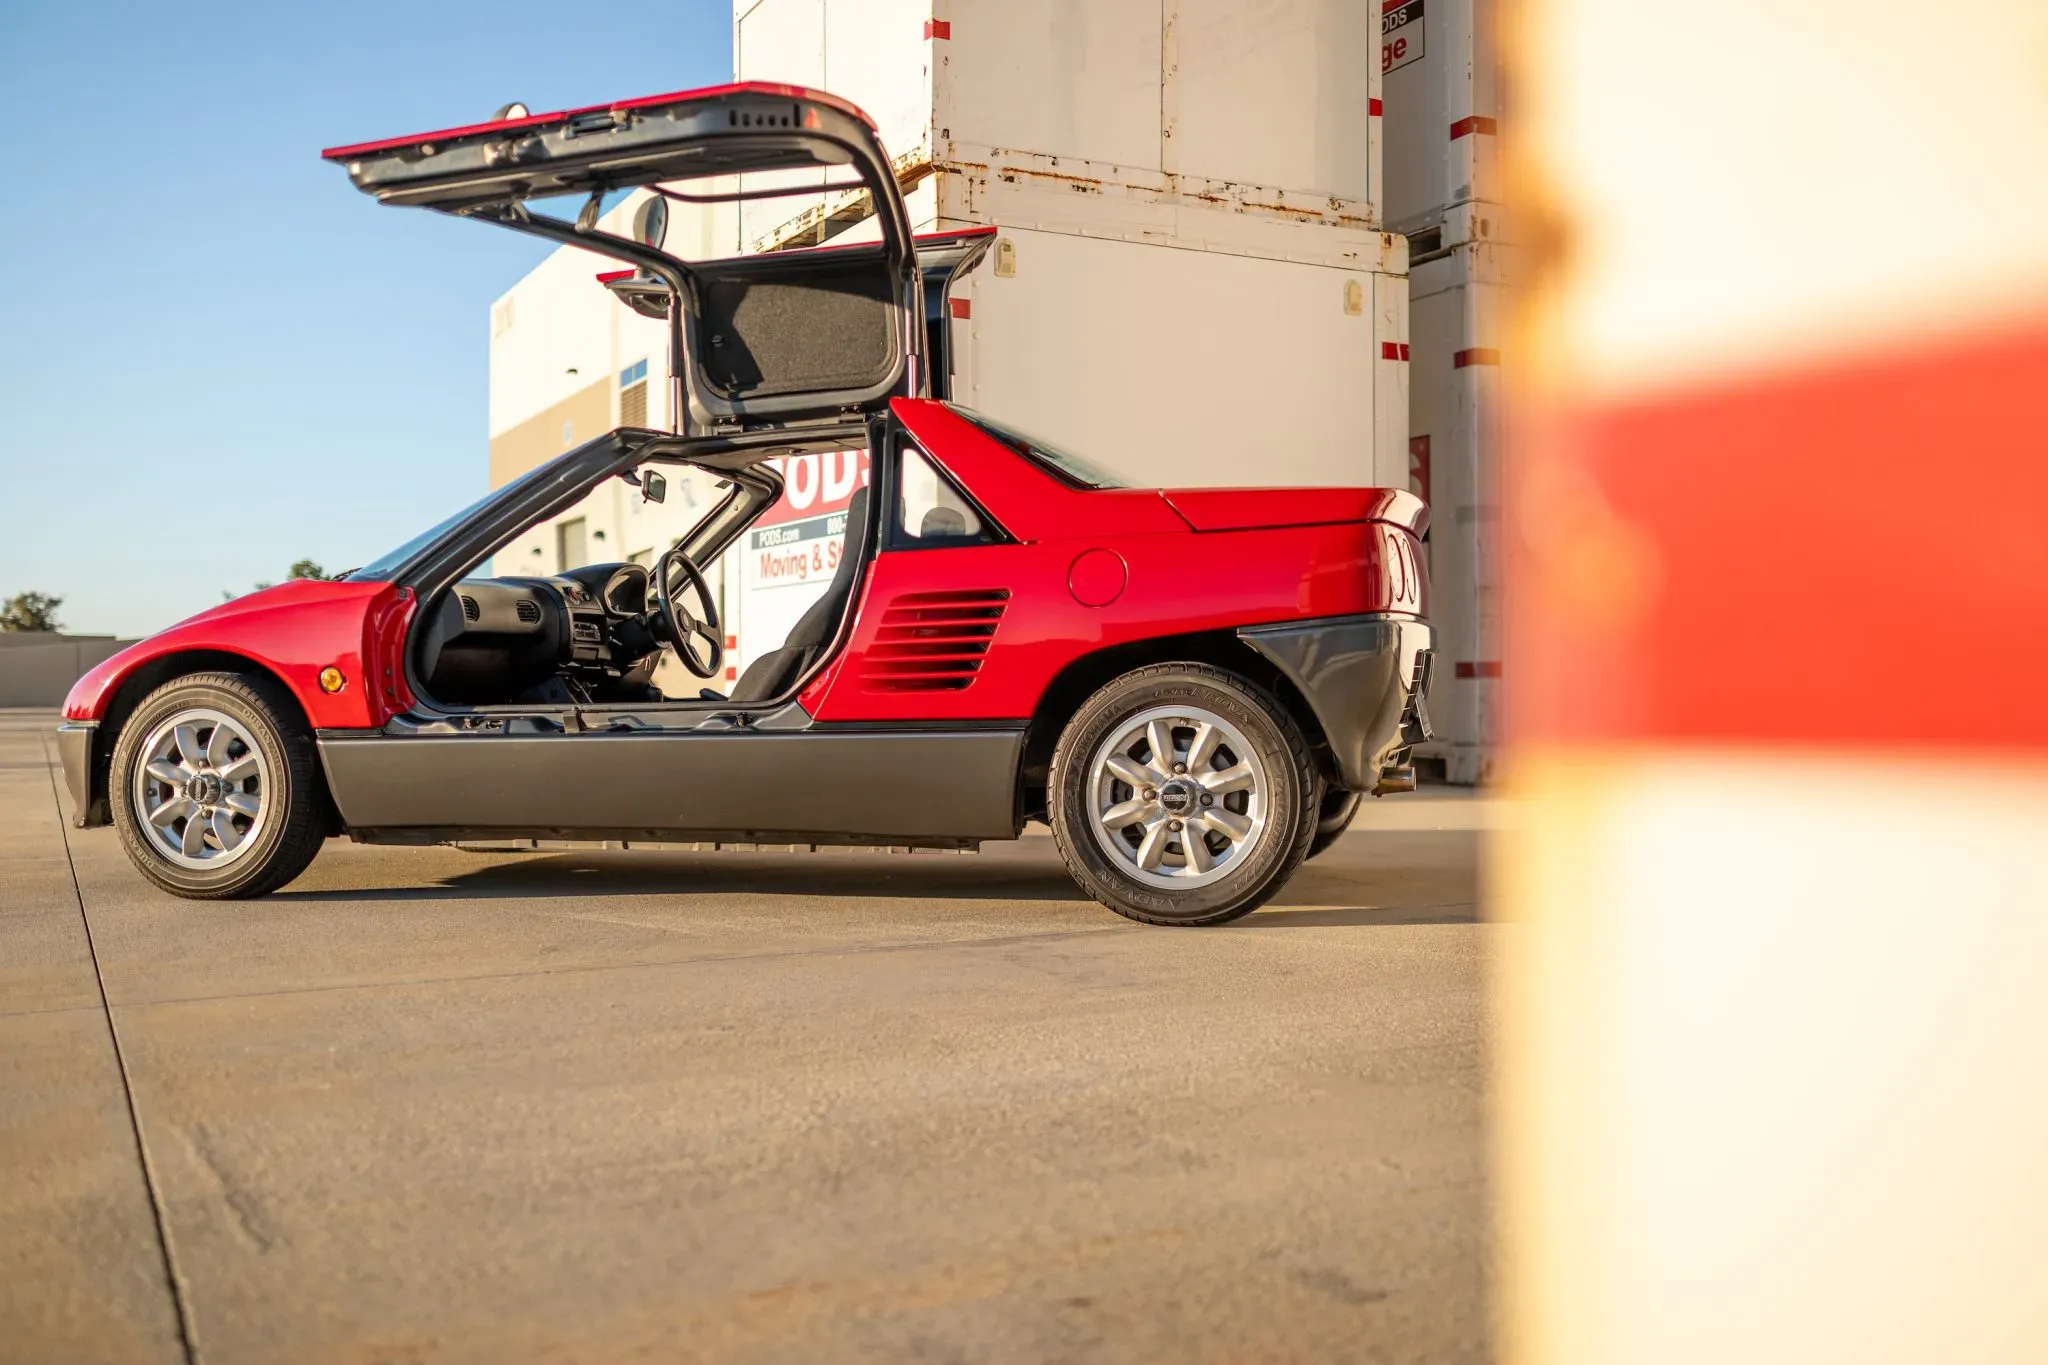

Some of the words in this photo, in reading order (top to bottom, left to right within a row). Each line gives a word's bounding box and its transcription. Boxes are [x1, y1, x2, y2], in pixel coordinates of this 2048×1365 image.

[758, 528, 799, 548] PODS.com
[760, 550, 807, 579] Moving
[813, 543, 822, 571] &
